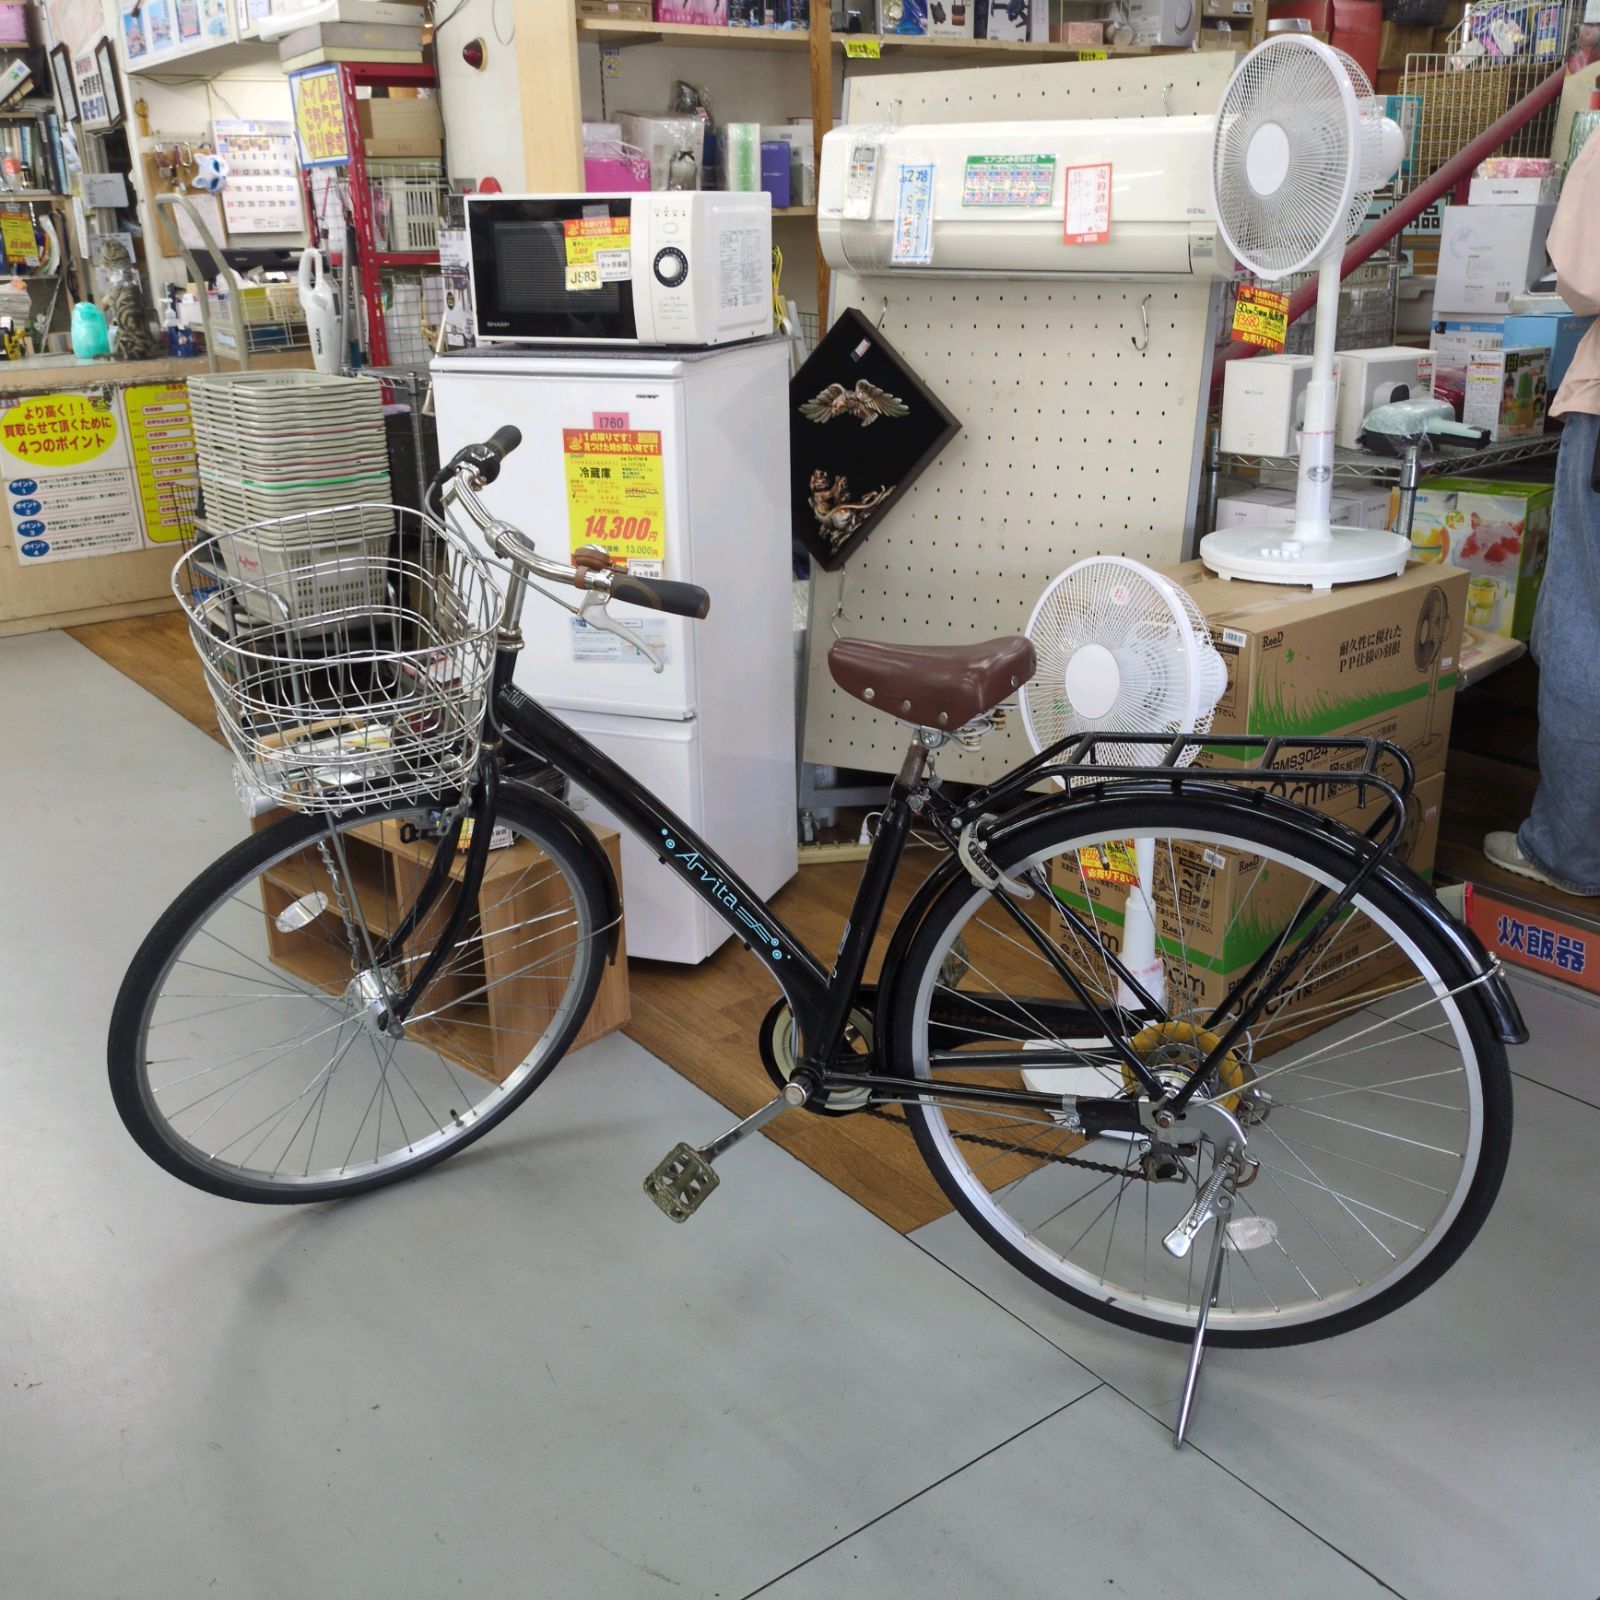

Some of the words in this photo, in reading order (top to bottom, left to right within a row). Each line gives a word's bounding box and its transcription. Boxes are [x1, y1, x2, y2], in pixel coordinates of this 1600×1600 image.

[300, 76, 338, 105] トイレは
[303, 103, 342, 130] こちらに
[307, 129, 345, 156] なります
[570, 270, 597, 284] J583
[4, 416, 112, 438] 買取らせて頂くために
[599, 417, 624, 429] 1760
[18, 433, 105, 455] 4つのポイント
[579, 467, 611, 479] 冷蔵庫
[11, 481, 34, 490] ポイント
[15, 501, 38, 511] ポイント
[19, 521, 41, 531] ポイント
[585, 515, 658, 541] 14,300円
[23, 542, 46, 551] ポイント
[1262, 631, 1284, 648] ReeD
[1339, 624, 1402, 658] 耐久性に優れた
[1238, 855, 1260, 873] ReeD
[675, 852, 738, 910] Arvita
[1497, 914, 1585, 974] 炊飯器
